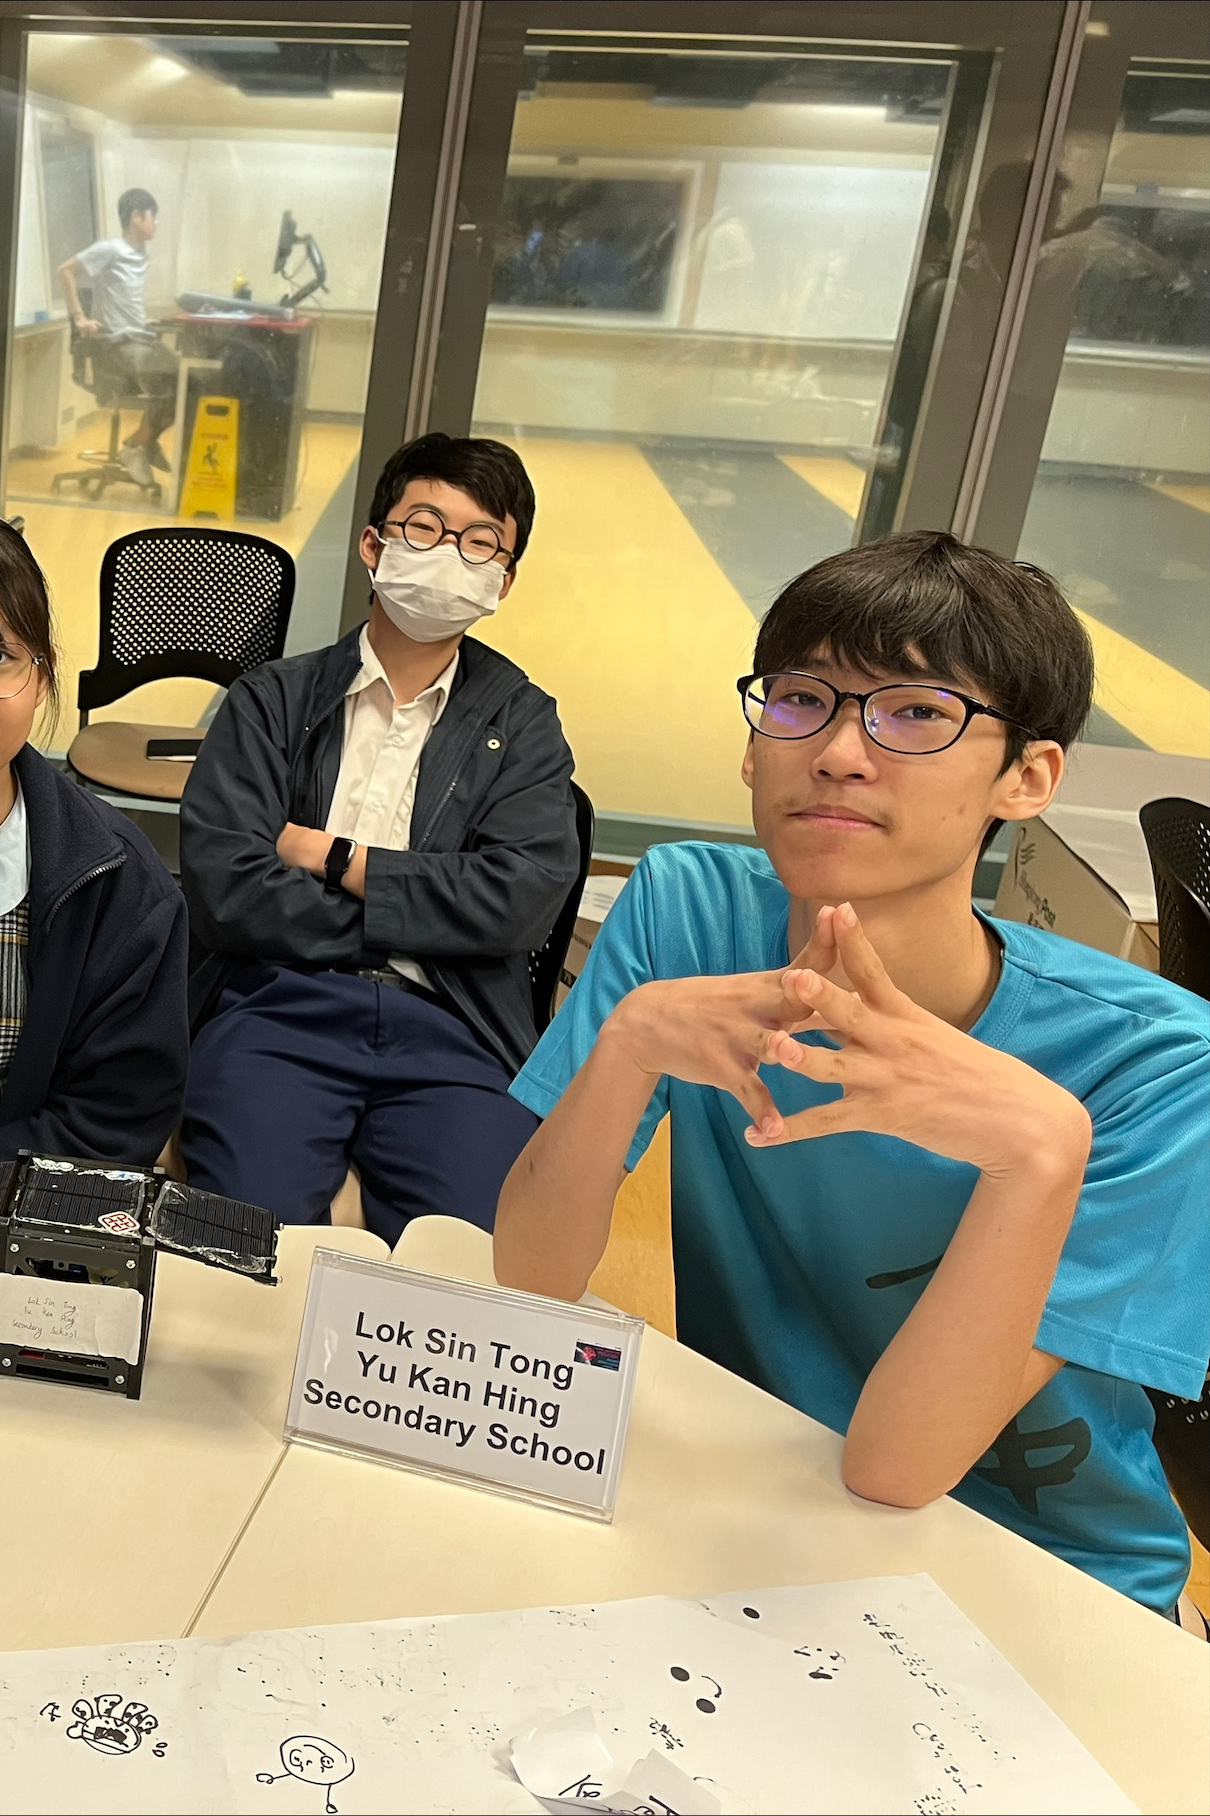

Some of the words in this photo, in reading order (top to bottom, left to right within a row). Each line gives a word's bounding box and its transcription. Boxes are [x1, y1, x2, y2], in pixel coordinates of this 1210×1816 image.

[23, 1305, 33, 1315] Yu
[27, 1296, 41, 1306] Lok
[43, 1297, 55, 1307] Sin
[51, 1326, 77, 1338] School
[355, 1311, 414, 1349] Lok
[424, 1328, 477, 1363] Sin
[489, 1341, 574, 1391] Tong
[356, 1350, 397, 1384] Yu
[408, 1363, 471, 1402] Kan
[482, 1381, 560, 1429] Hing
[303, 1378, 477, 1448] Secondary
[486, 1423, 606, 1475] School
